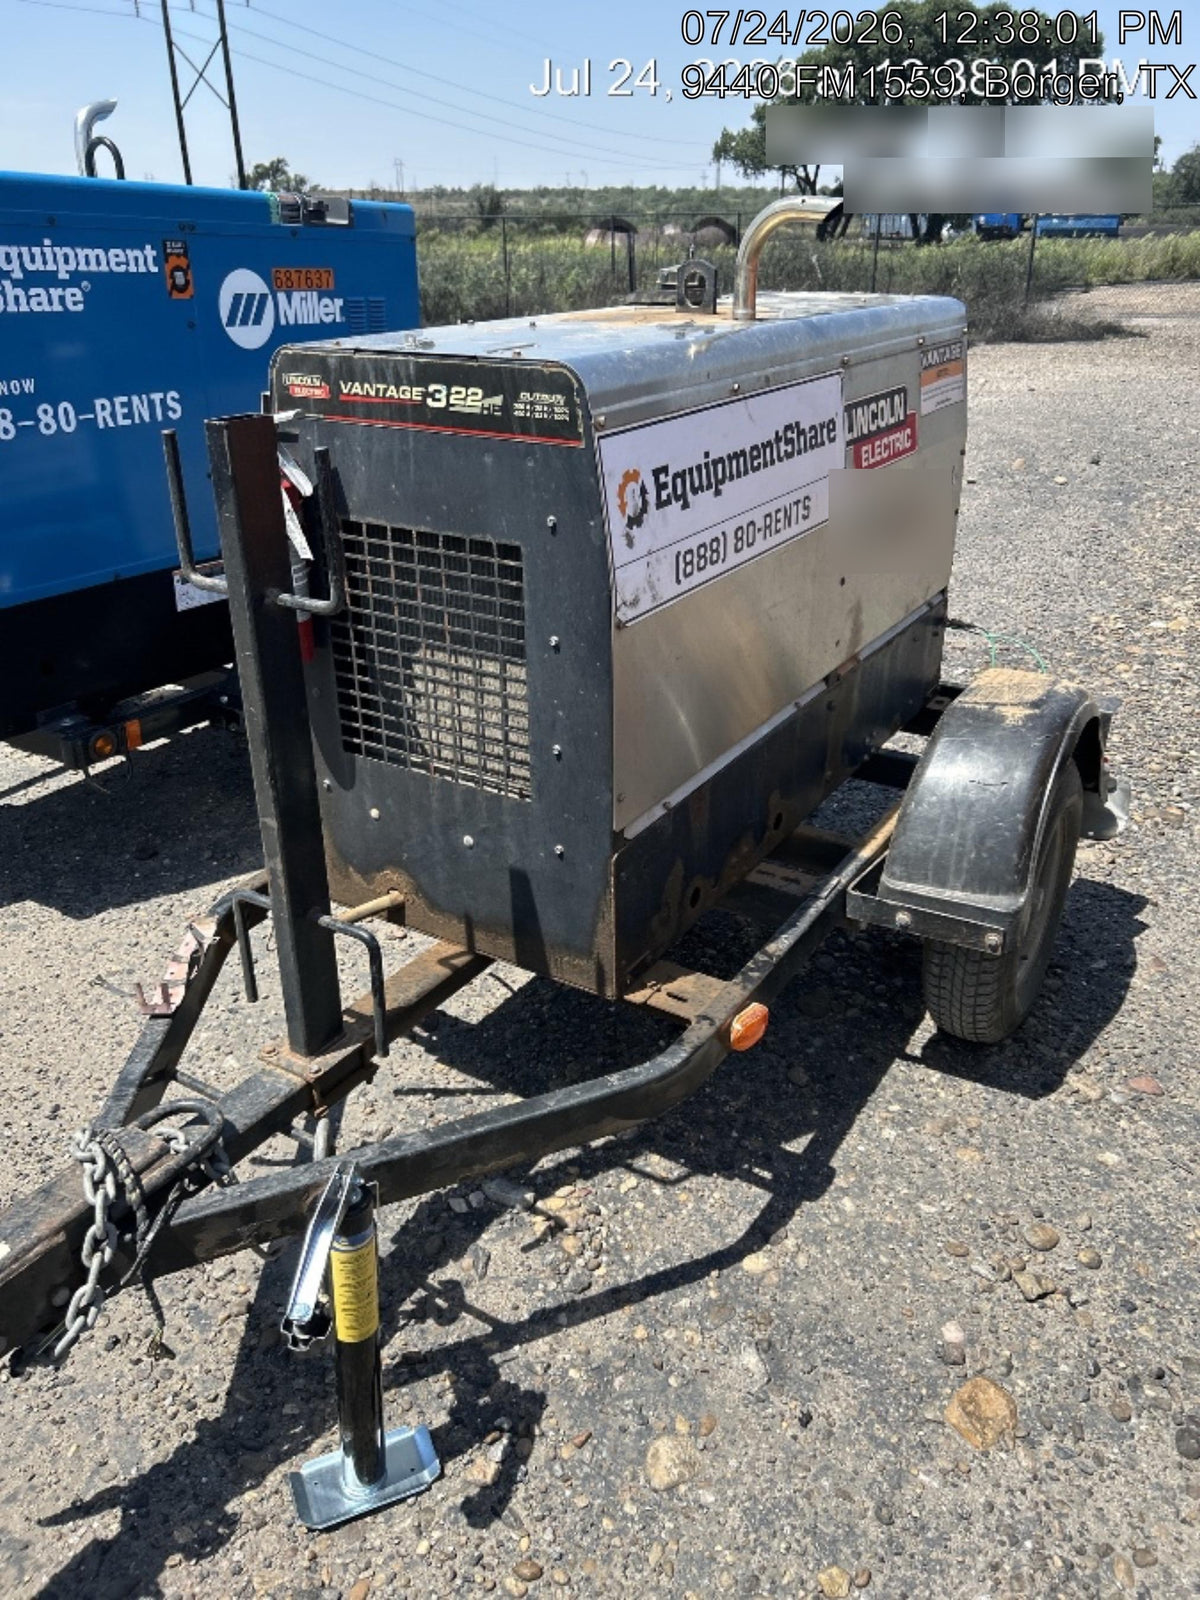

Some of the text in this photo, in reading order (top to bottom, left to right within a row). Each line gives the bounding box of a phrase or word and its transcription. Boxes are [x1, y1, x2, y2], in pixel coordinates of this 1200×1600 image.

[274, 269, 333, 289] 687637
[277, 291, 345, 326] Miller
[0, 378, 35, 396] NOW
[339, 380, 425, 401] VANTAGE
[426, 383, 483, 409] 322
[844, 392, 905, 442] LINCOLN
[652, 413, 838, 510] EquipmentShare
[861, 427, 912, 468] ELECTRIC
[674, 495, 812, 585] (888) 80-RENTS
